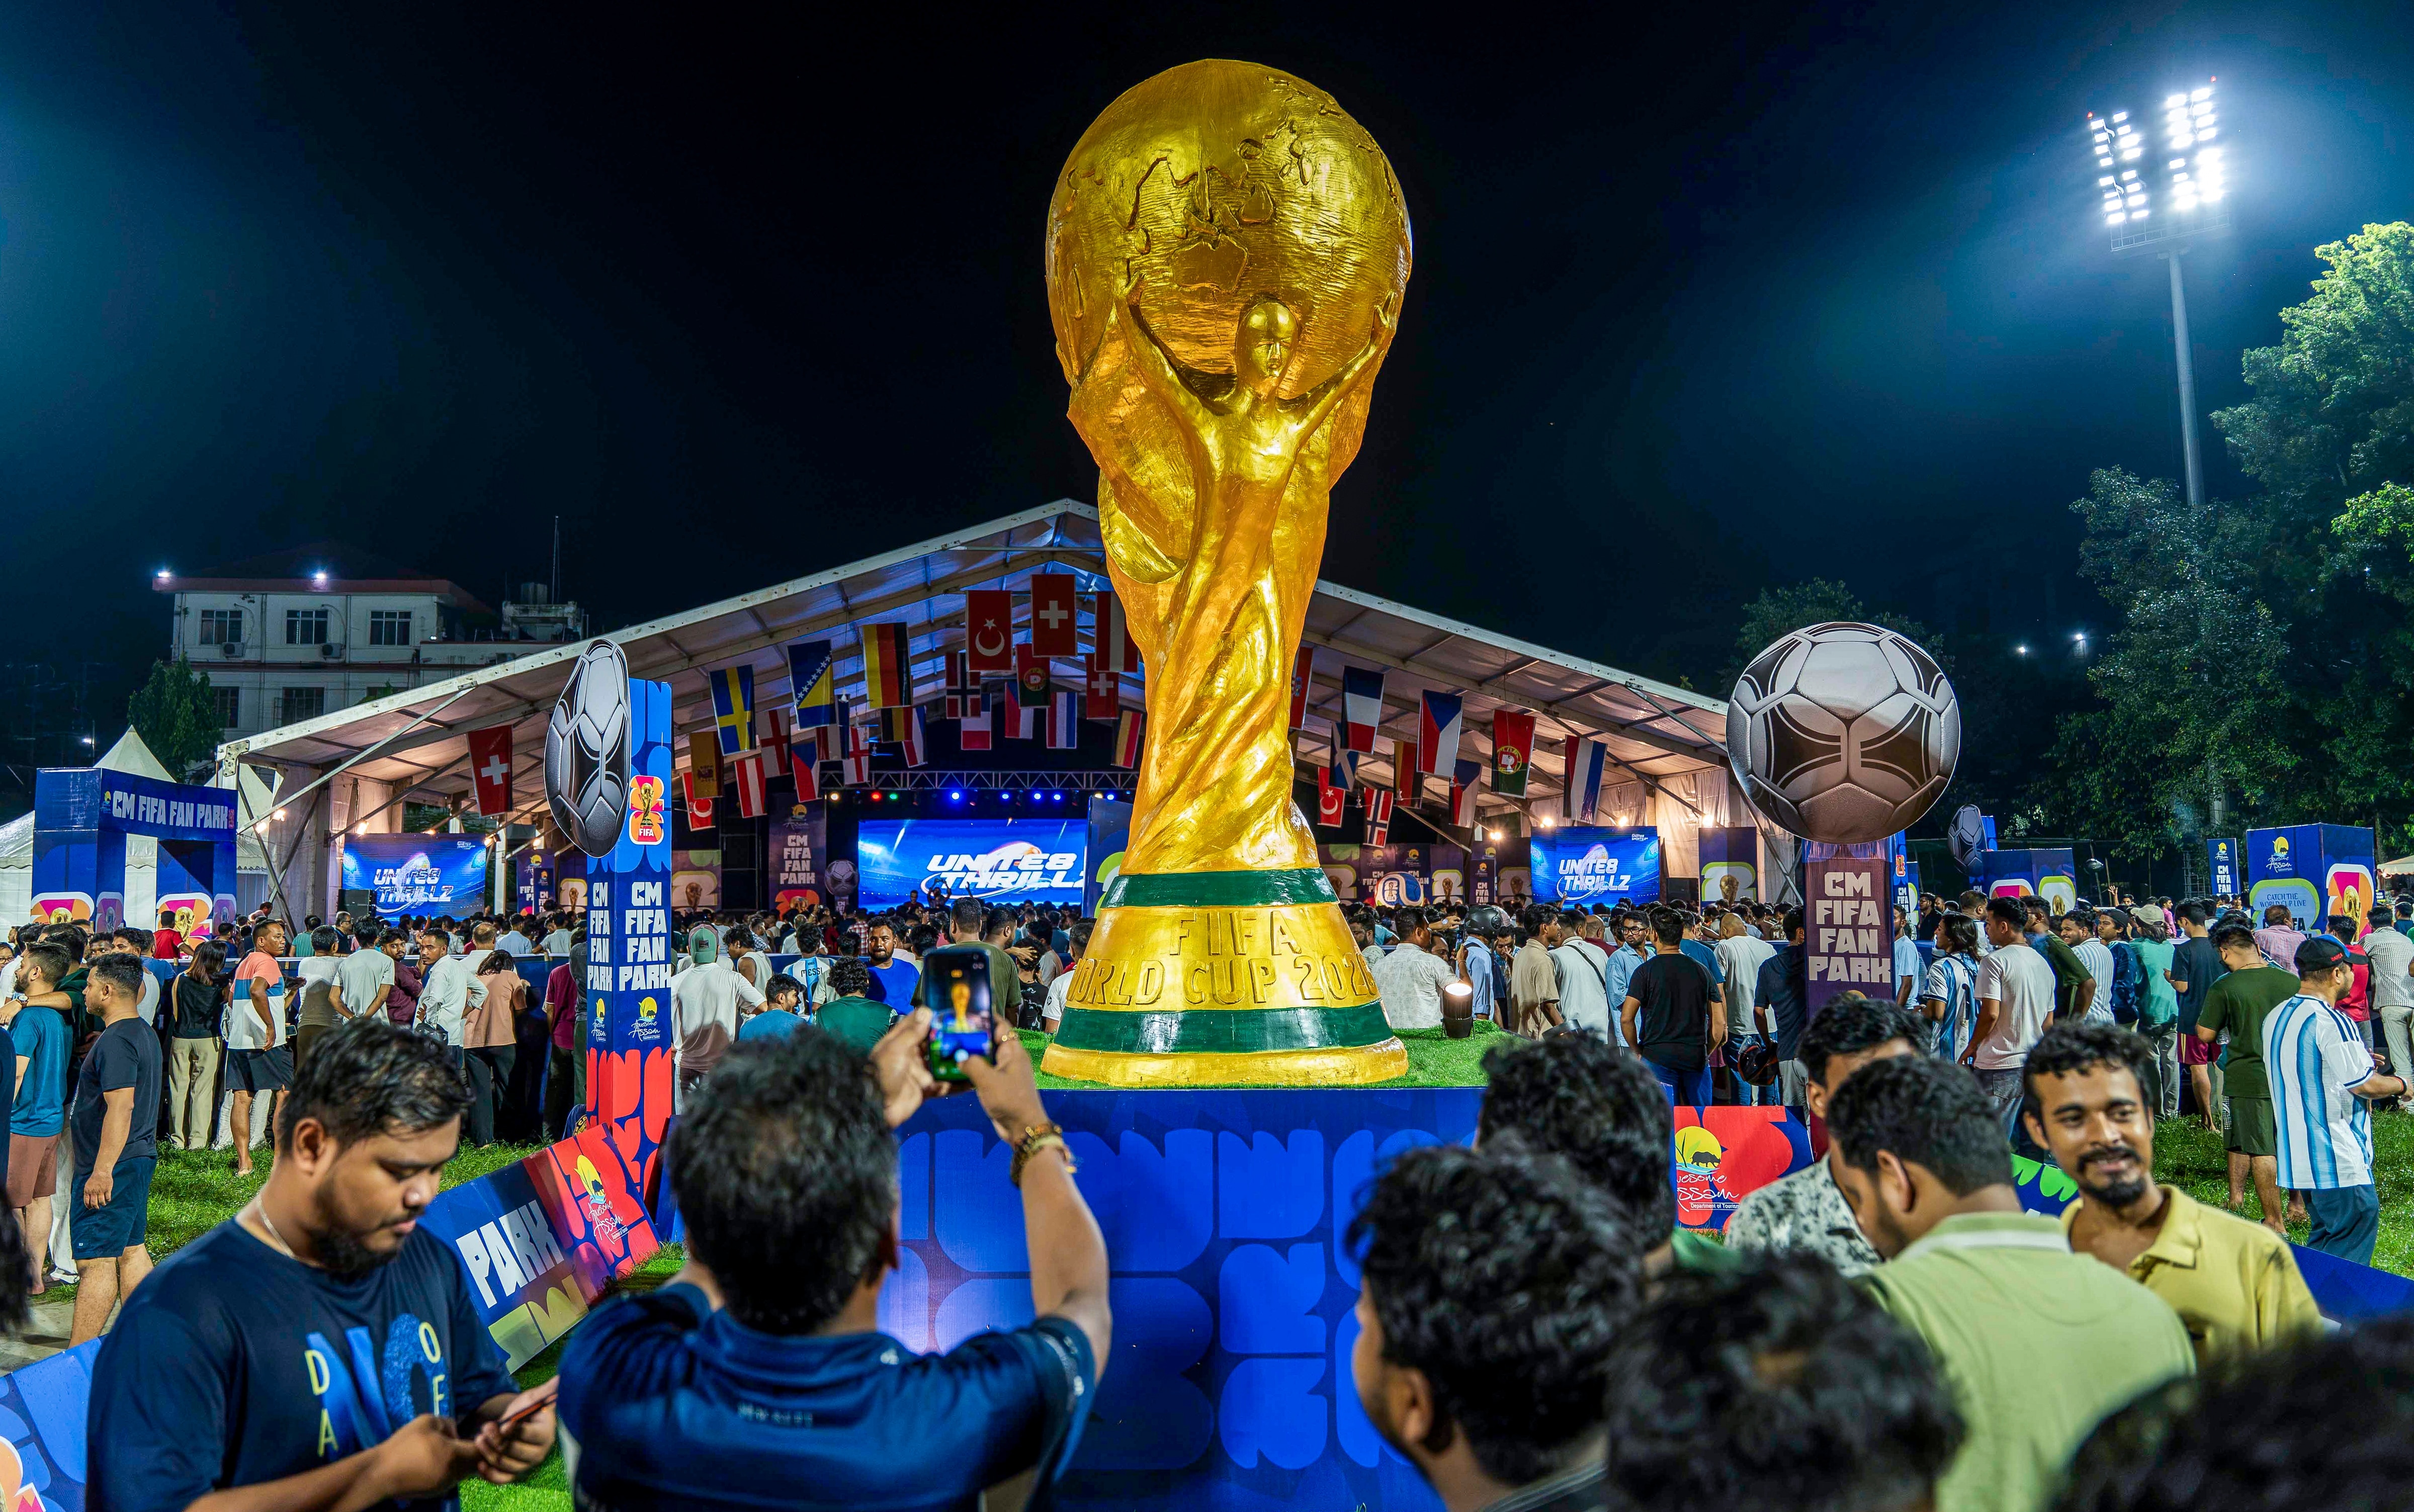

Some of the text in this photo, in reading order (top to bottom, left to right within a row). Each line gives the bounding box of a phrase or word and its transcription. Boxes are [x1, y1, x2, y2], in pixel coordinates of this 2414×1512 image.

[113, 791, 228, 829] CM FIFA FAN PARK
[639, 828, 654, 837] FIFA
[788, 835, 808, 846] CM
[784, 847, 811, 859] FIFA
[785, 860, 810, 871] FAN
[780, 872, 816, 884] PARK
[2216, 874, 2231, 883] FIFA
[2217, 865, 2229, 874] CM
[593, 882, 609, 907] CM
[632, 881, 662, 907] CM
[1825, 872, 1871, 897] CM
[1898, 887, 1907, 896] CM
[2218, 884, 2231, 893] FAN
[1897, 896, 1909, 904] FIFA
[590, 910, 610, 935] FIFA
[625, 909, 667, 935] FIFA
[1816, 900, 1881, 926] FIFA
[1169, 911, 1302, 955] FIFA
[1820, 928, 1878, 954] FAN
[590, 938, 610, 963] FAN
[627, 936, 665, 962] FAN
[587, 965, 613, 992] PARK
[619, 963, 672, 992] PARK
[801, 966, 823, 977] MESSI
[1183, 958, 1277, 1005] CUP
[1808, 956, 1891, 983] PARK
[628, 1026, 661, 1042] Assam
[631, 1019, 658, 1029] Awesome
[1677, 1174, 1727, 1183] esome
[1677, 1187, 1740, 1201] ssam
[593, 1214, 623, 1244] Assam
[455, 1199, 564, 1309] PARK
